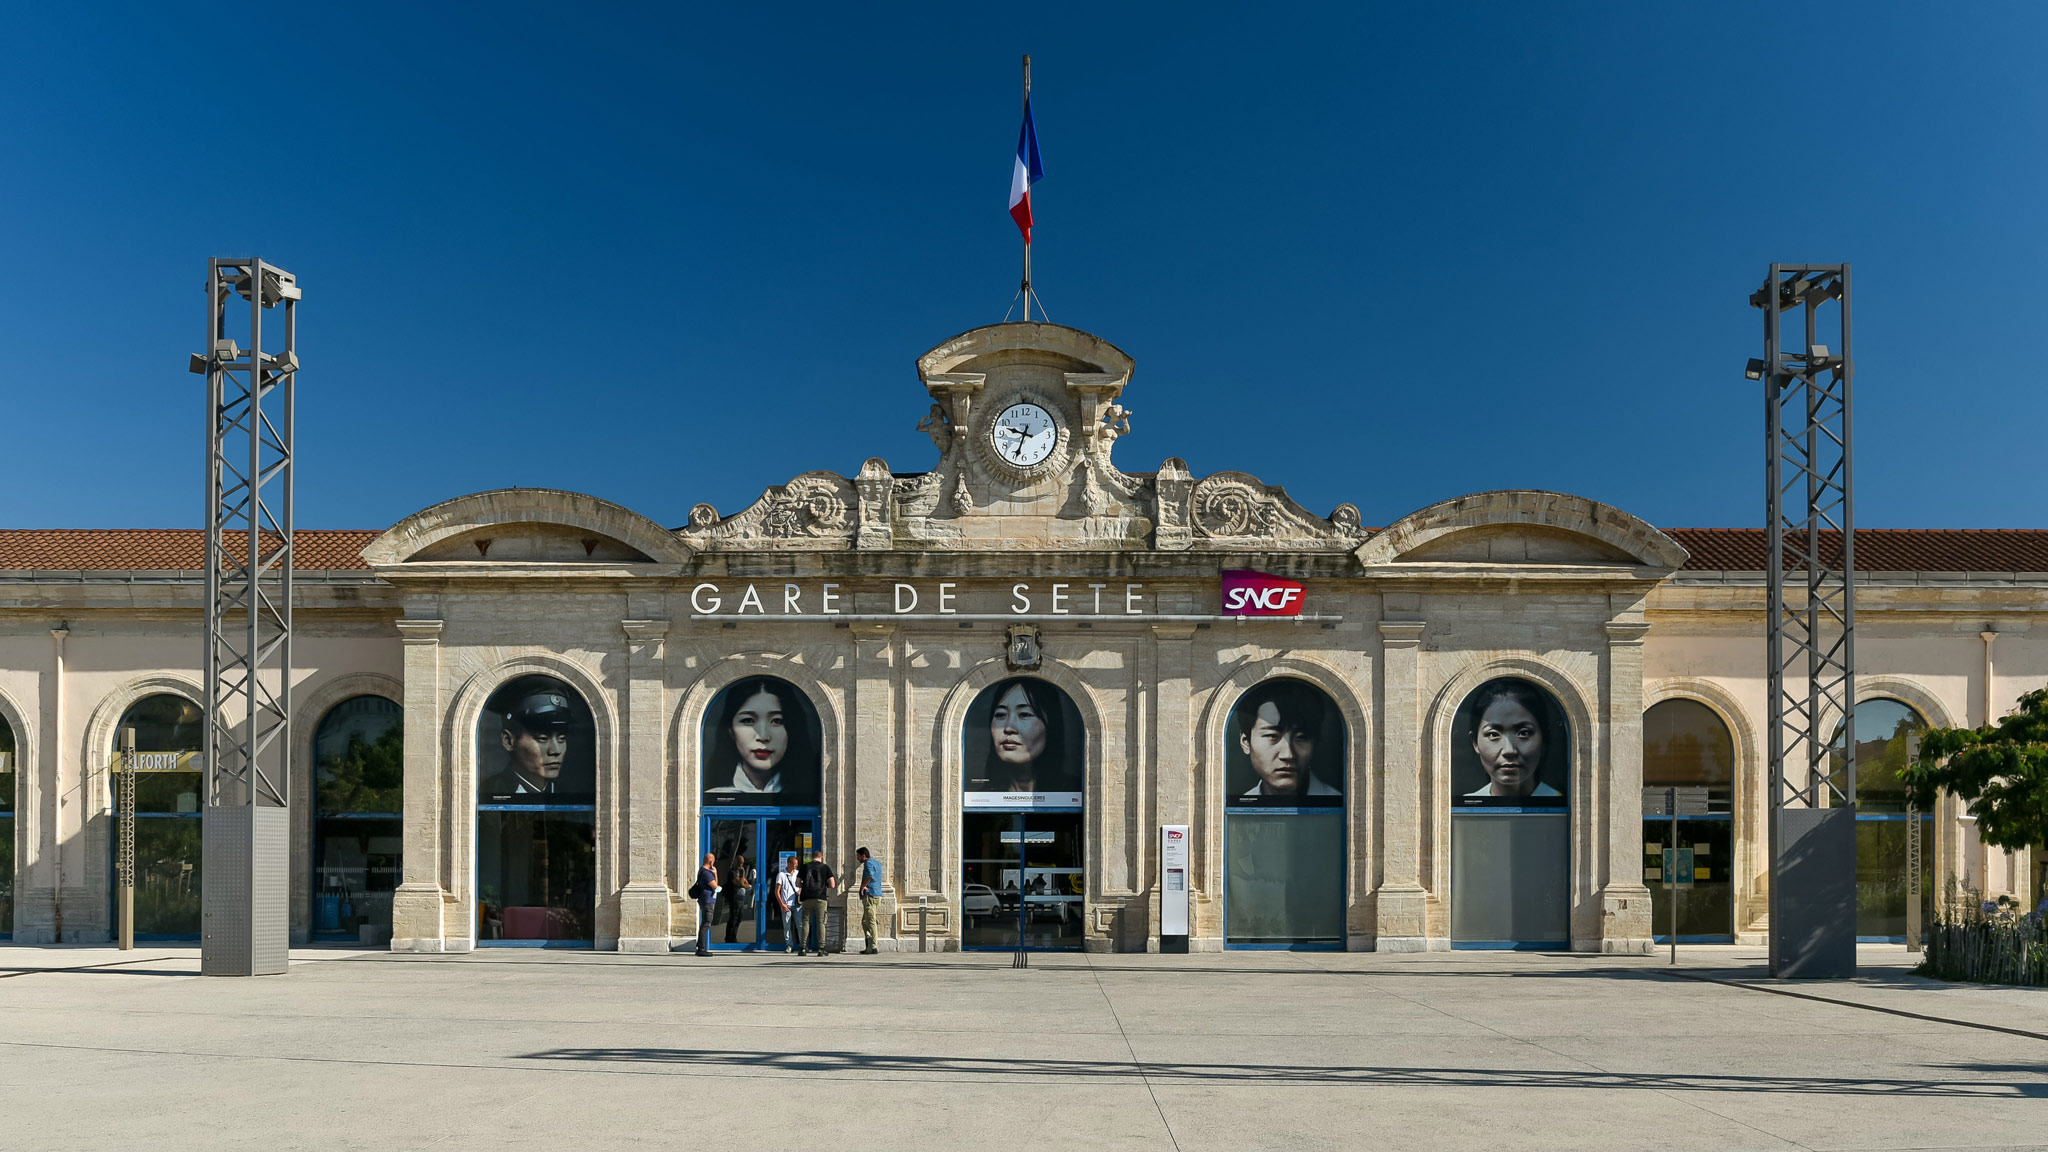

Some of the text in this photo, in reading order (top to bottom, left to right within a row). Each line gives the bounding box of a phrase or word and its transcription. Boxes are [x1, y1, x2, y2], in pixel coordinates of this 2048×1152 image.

[1011, 410, 1018, 418] 11
[1021, 407, 1030, 416] 12
[1001, 418, 1010, 426] 10
[1043, 419, 1048, 427] 2
[999, 430, 1005, 438] 9
[1045, 431, 1051, 439] 3
[1002, 442, 1008, 450] 8
[1040, 443, 1046, 451] 4
[1021, 454, 1027, 462] 6
[1033, 451, 1038, 459] 5
[691, 583, 1142, 614] GARE DE SETE
[1225, 587, 1301, 610] SNCF
[122, 754, 177, 769] LFORTH
